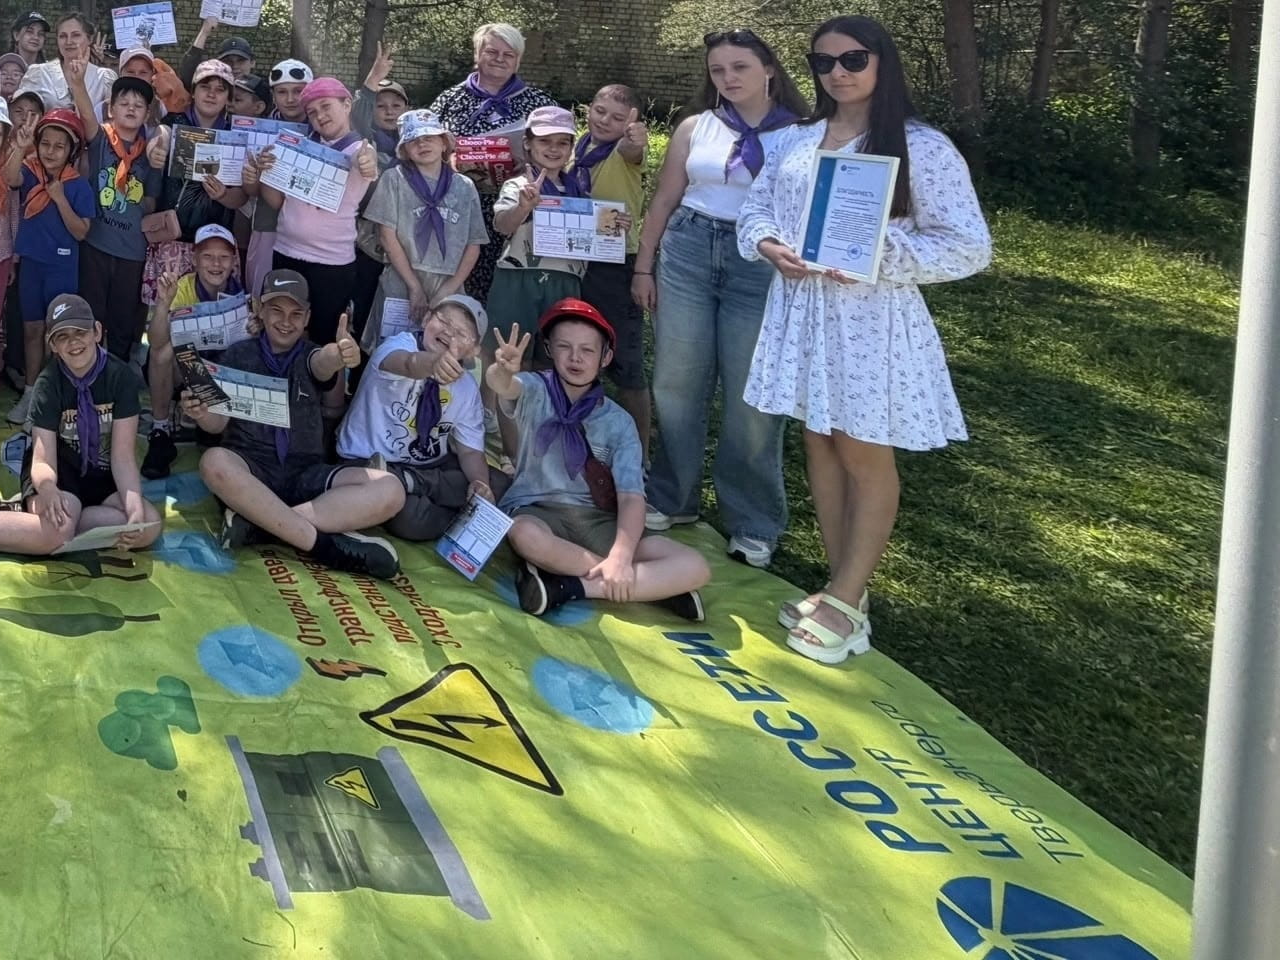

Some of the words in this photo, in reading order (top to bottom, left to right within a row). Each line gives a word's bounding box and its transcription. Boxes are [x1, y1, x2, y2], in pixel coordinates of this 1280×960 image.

[277, 588, 326, 647] Открыл
[662, 632, 953, 854] РОССЕТИ
[862, 747, 1024, 859] ЦЕНТР
